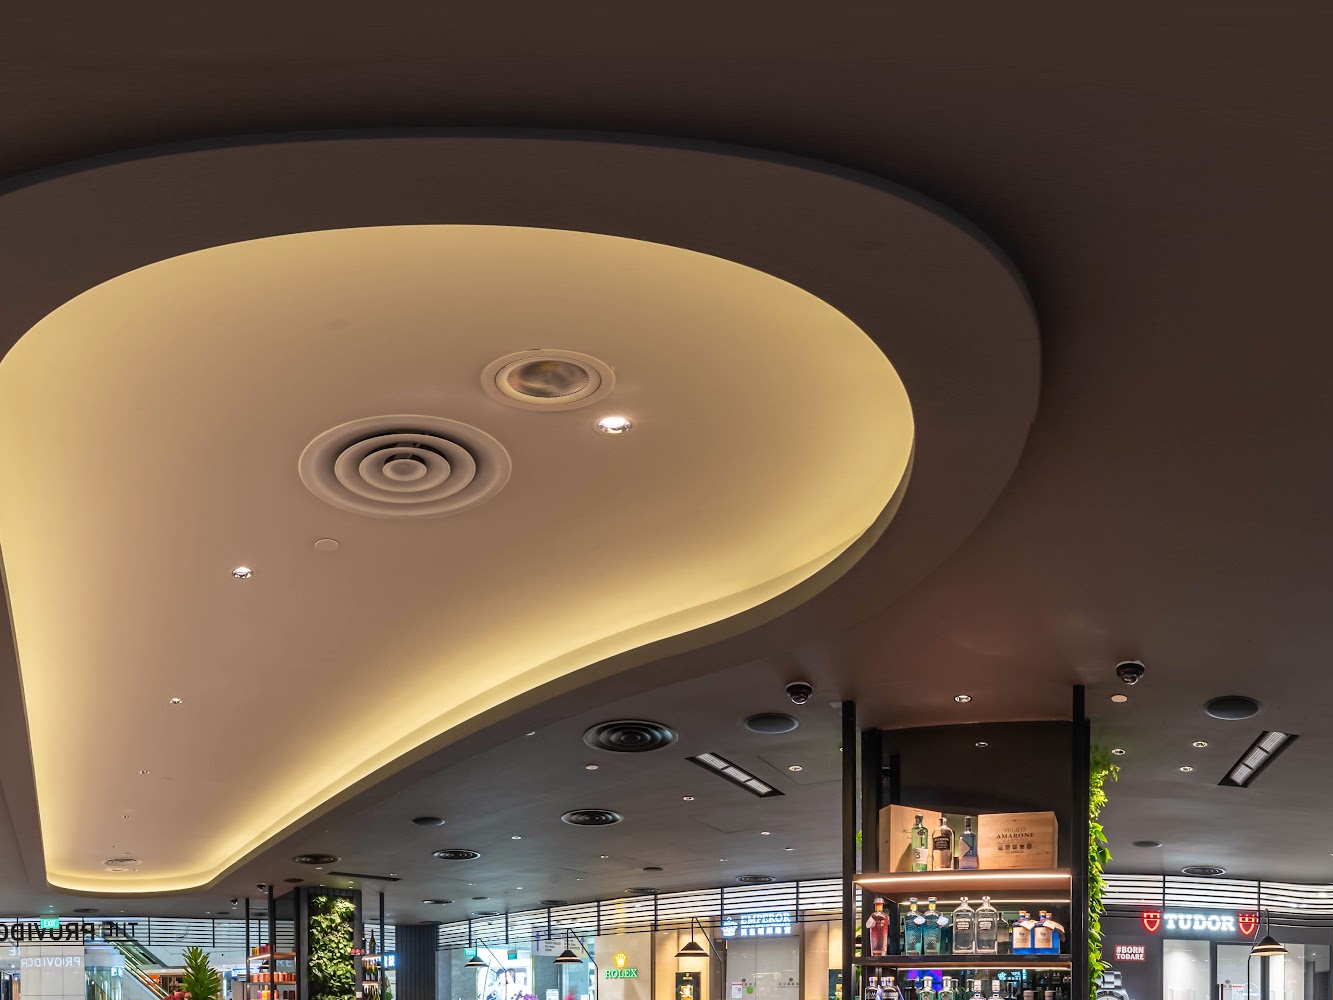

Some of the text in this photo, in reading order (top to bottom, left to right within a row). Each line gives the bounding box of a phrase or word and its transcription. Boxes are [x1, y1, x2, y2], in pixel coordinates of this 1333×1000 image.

[43, 919, 57, 928] EXIT
[740, 912, 792, 925] EMPEROR
[1163, 913, 1236, 931] TUDOR
[1115, 946, 1145, 954] #BORN
[604, 968, 638, 979] ROLEX
